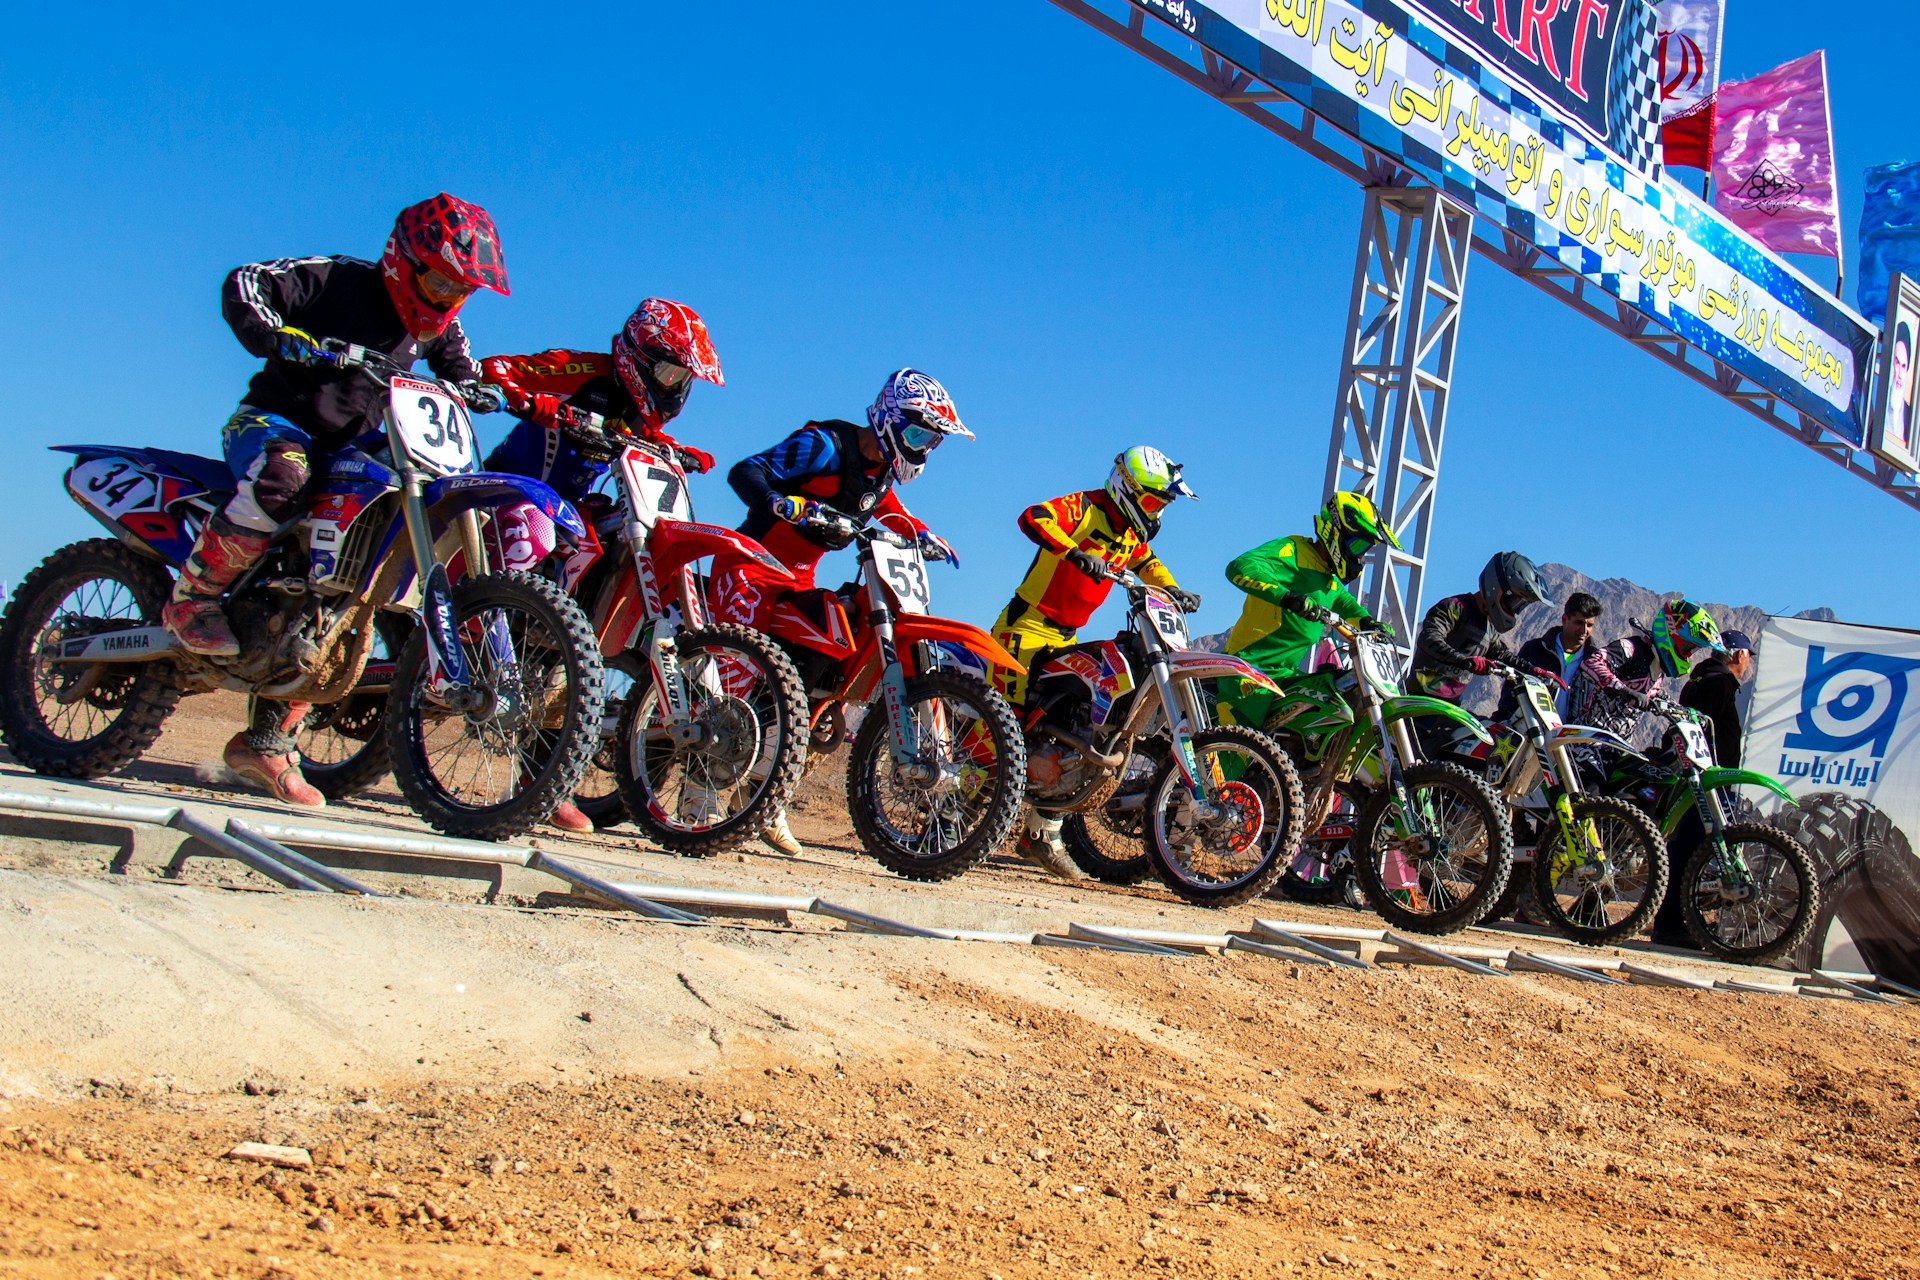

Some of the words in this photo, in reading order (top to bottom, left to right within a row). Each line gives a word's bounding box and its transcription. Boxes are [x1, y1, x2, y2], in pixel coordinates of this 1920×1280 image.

[1329, 19, 1394, 97] آیت
[1544, 169, 1562, 219] و
[1698, 274, 1767, 351] ورزشی
[1772, 311, 1843, 392] مجموعه
[417, 396, 464, 455] 34
[88, 463, 145, 508] 34
[339, 460, 365, 473] YAMAHA
[647, 466, 680, 513] 7
[886, 558, 929, 605] 53
[1232, 574, 1278, 592] thor
[103, 634, 149, 650] YAMAHA
[433, 590, 460, 668] DUNLOP
[1372, 649, 1396, 683] 88
[887, 686, 903, 745] PIRELLI
[1298, 687, 1329, 702] KX
[1778, 754, 1826, 784] یاسا
[1826, 758, 1882, 787] ایران
